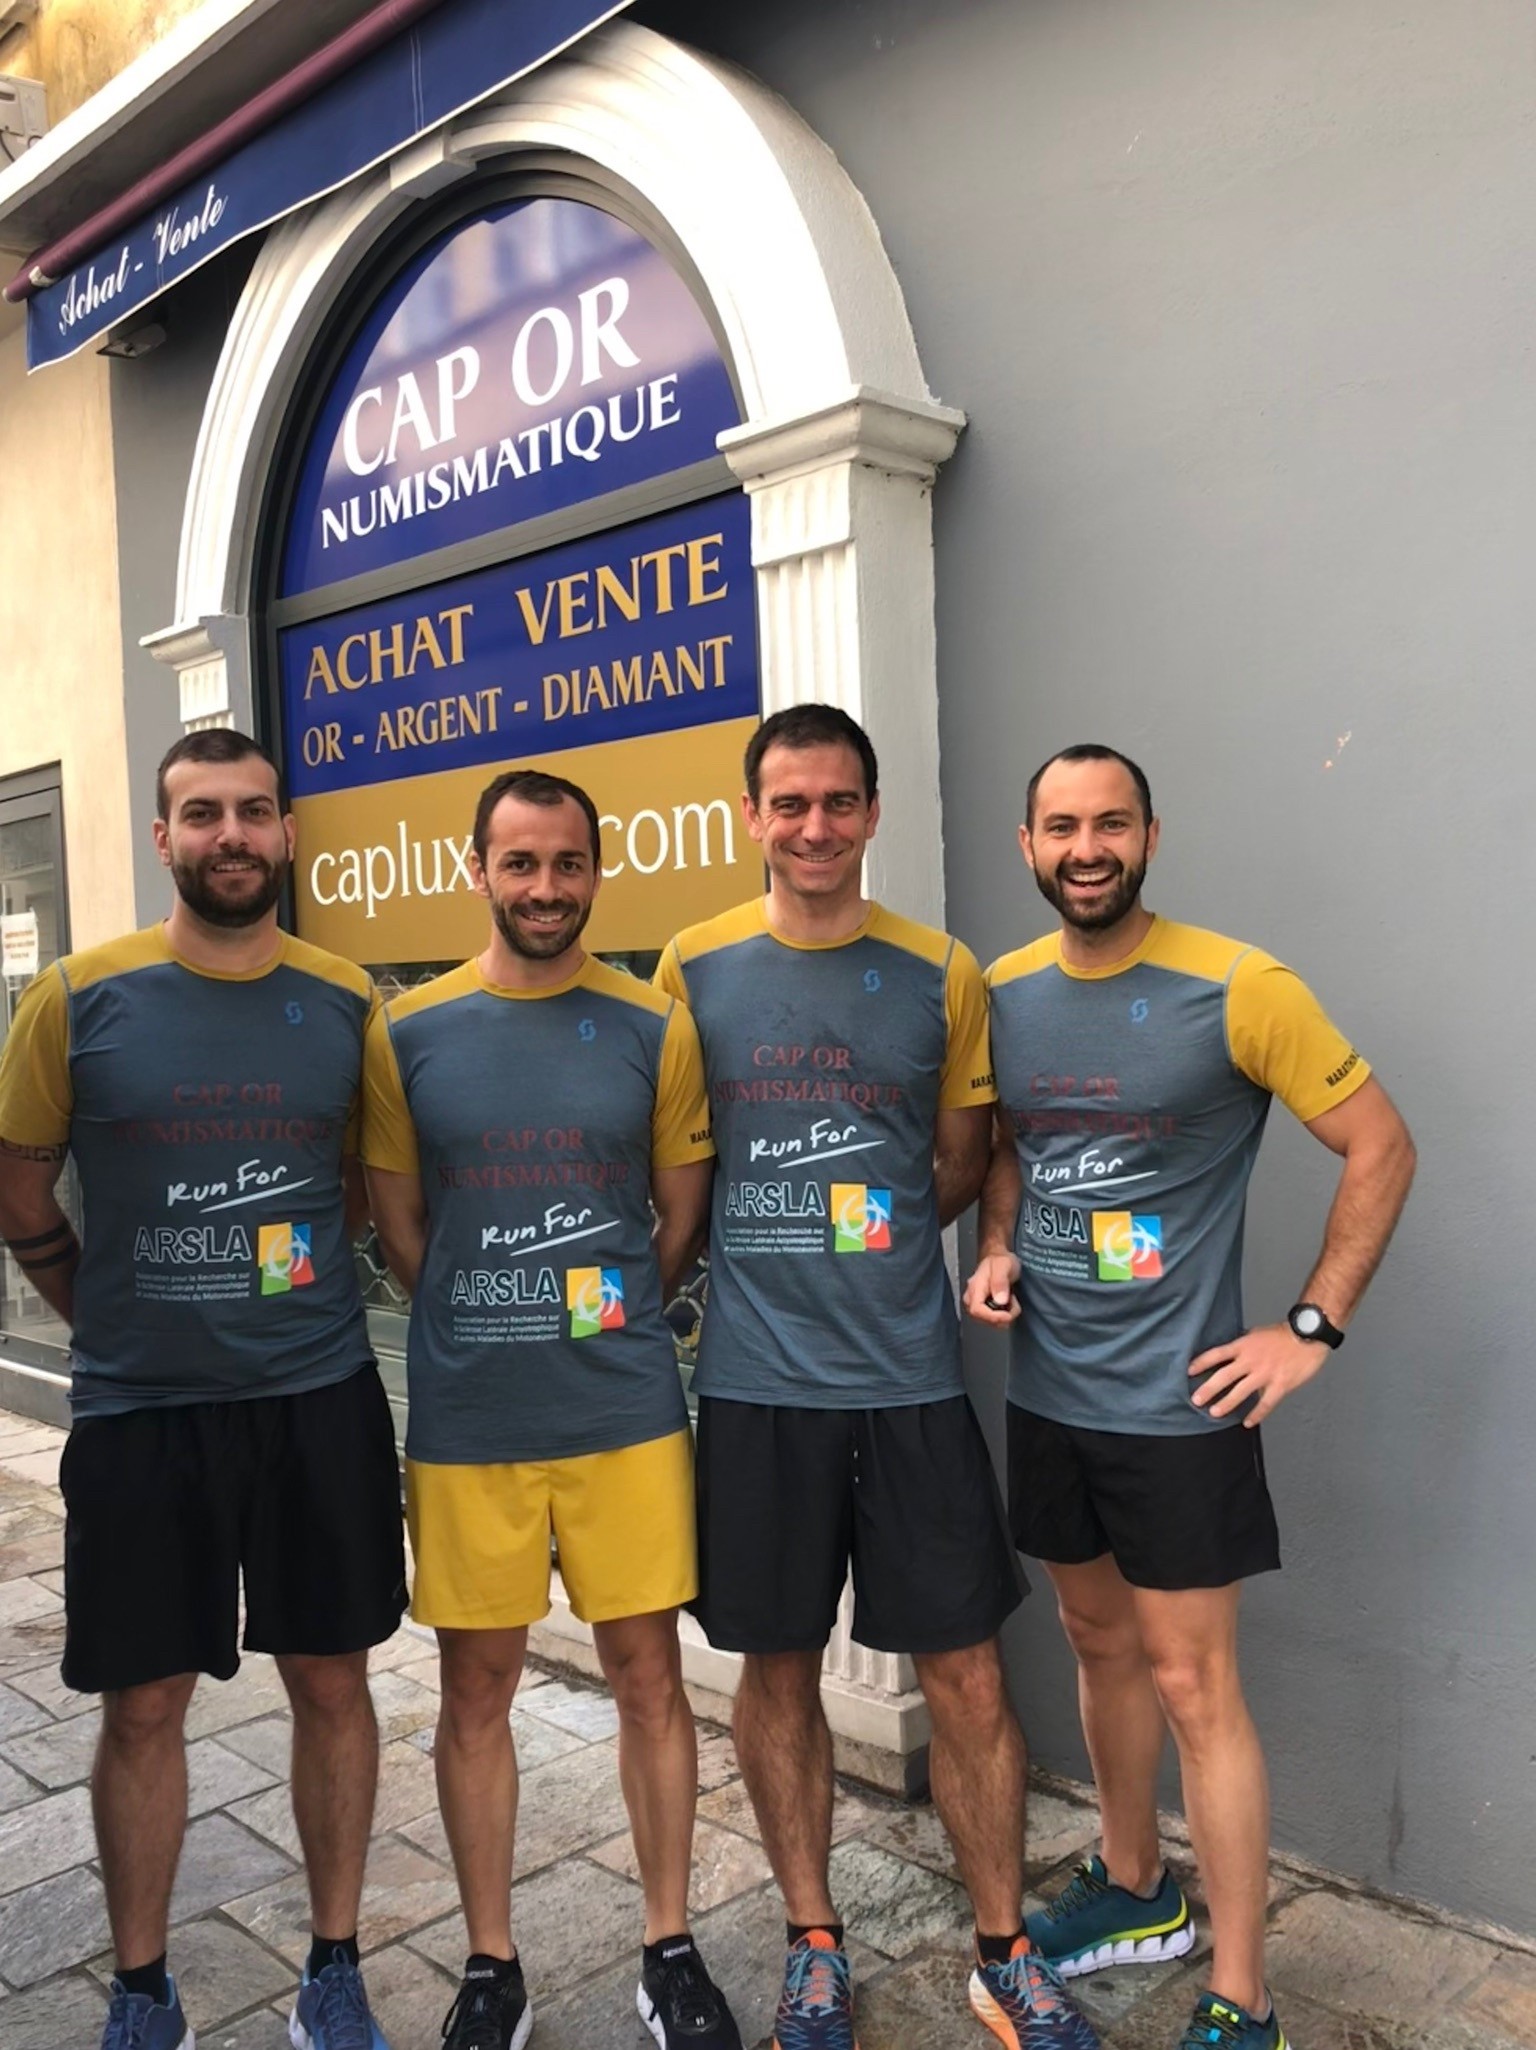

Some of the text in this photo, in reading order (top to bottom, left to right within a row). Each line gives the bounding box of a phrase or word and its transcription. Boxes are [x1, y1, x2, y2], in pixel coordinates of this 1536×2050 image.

[59, 246, 130, 336] Achat
[152, 184, 228, 265] Vente
[342, 277, 641, 476] CAP OR
[321, 373, 682, 549] NUMISMATIQUE
[303, 533, 729, 700] ACHAT VENTE
[302, 721, 346, 768] OR
[374, 687, 502, 754] ARGENT
[542, 635, 733, 723] DIAMANT
[754, 1045, 852, 1070] CAP OR
[172, 1083, 283, 1107] CAP OR
[714, 1078, 901, 1113] NUMISMATIQUE
[482, 1127, 585, 1153] CAP OR
[750, 1117, 858, 1163] Run For
[166, 1158, 289, 1208] Run For
[437, 1160, 630, 1193] NUMISMATIQUE
[1031, 1148, 1124, 1184] Run For
[725, 1181, 826, 1218] ARSLA
[133, 1225, 253, 1265] ARSLA
[481, 1201, 593, 1251] Run For
[451, 1267, 561, 1306] ARSLA
